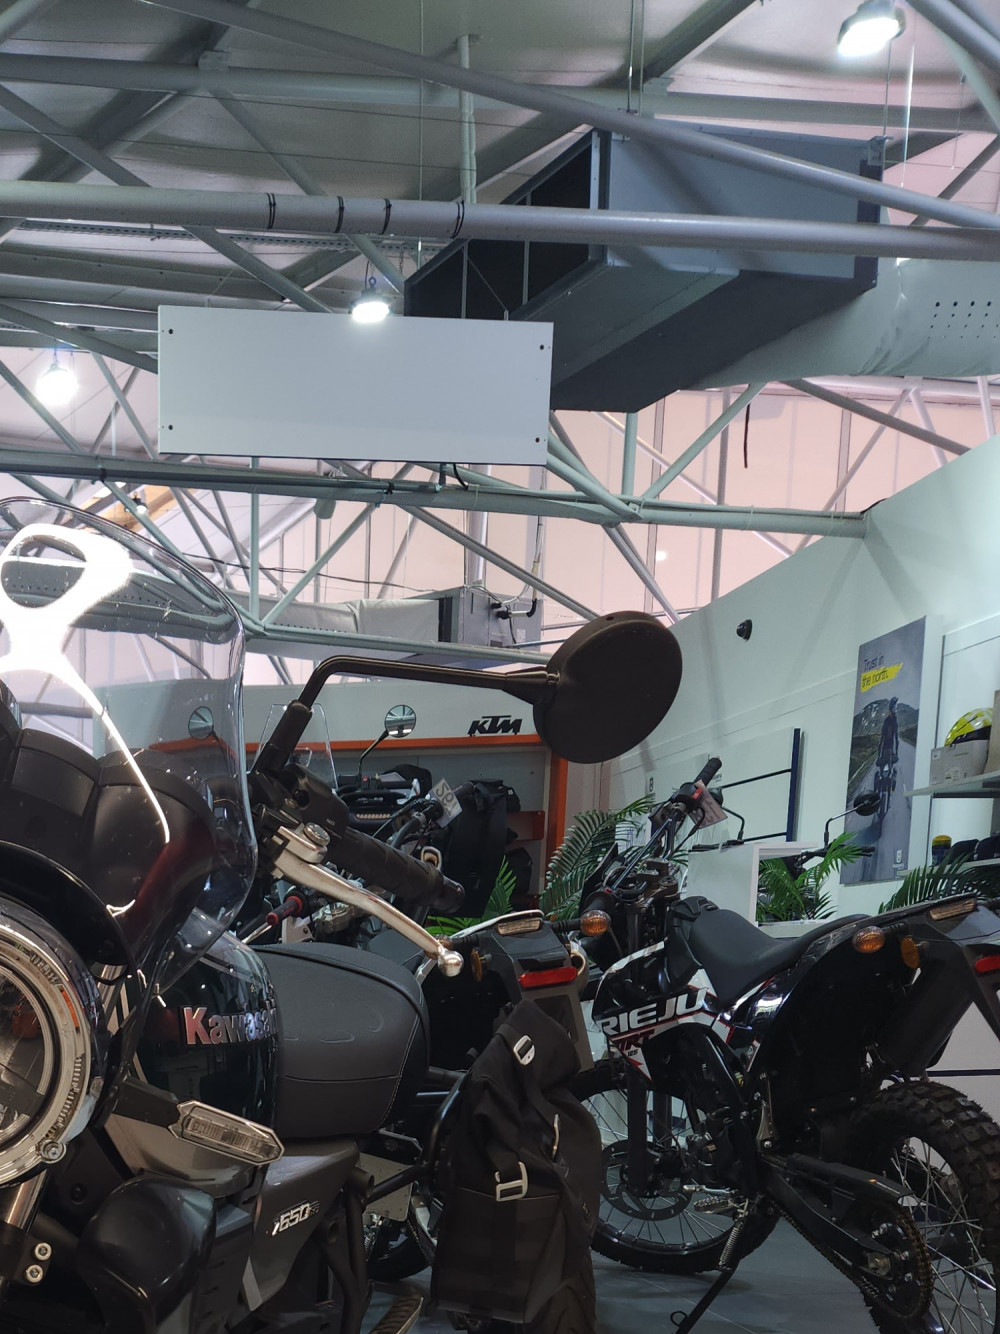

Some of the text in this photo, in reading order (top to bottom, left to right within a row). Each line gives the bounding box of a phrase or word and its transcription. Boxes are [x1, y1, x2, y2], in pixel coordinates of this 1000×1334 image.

[863, 656, 878, 672] Trust
[862, 674, 872, 688] the
[467, 715, 523, 735] KTM
[597, 987, 708, 1036] RIEJU
